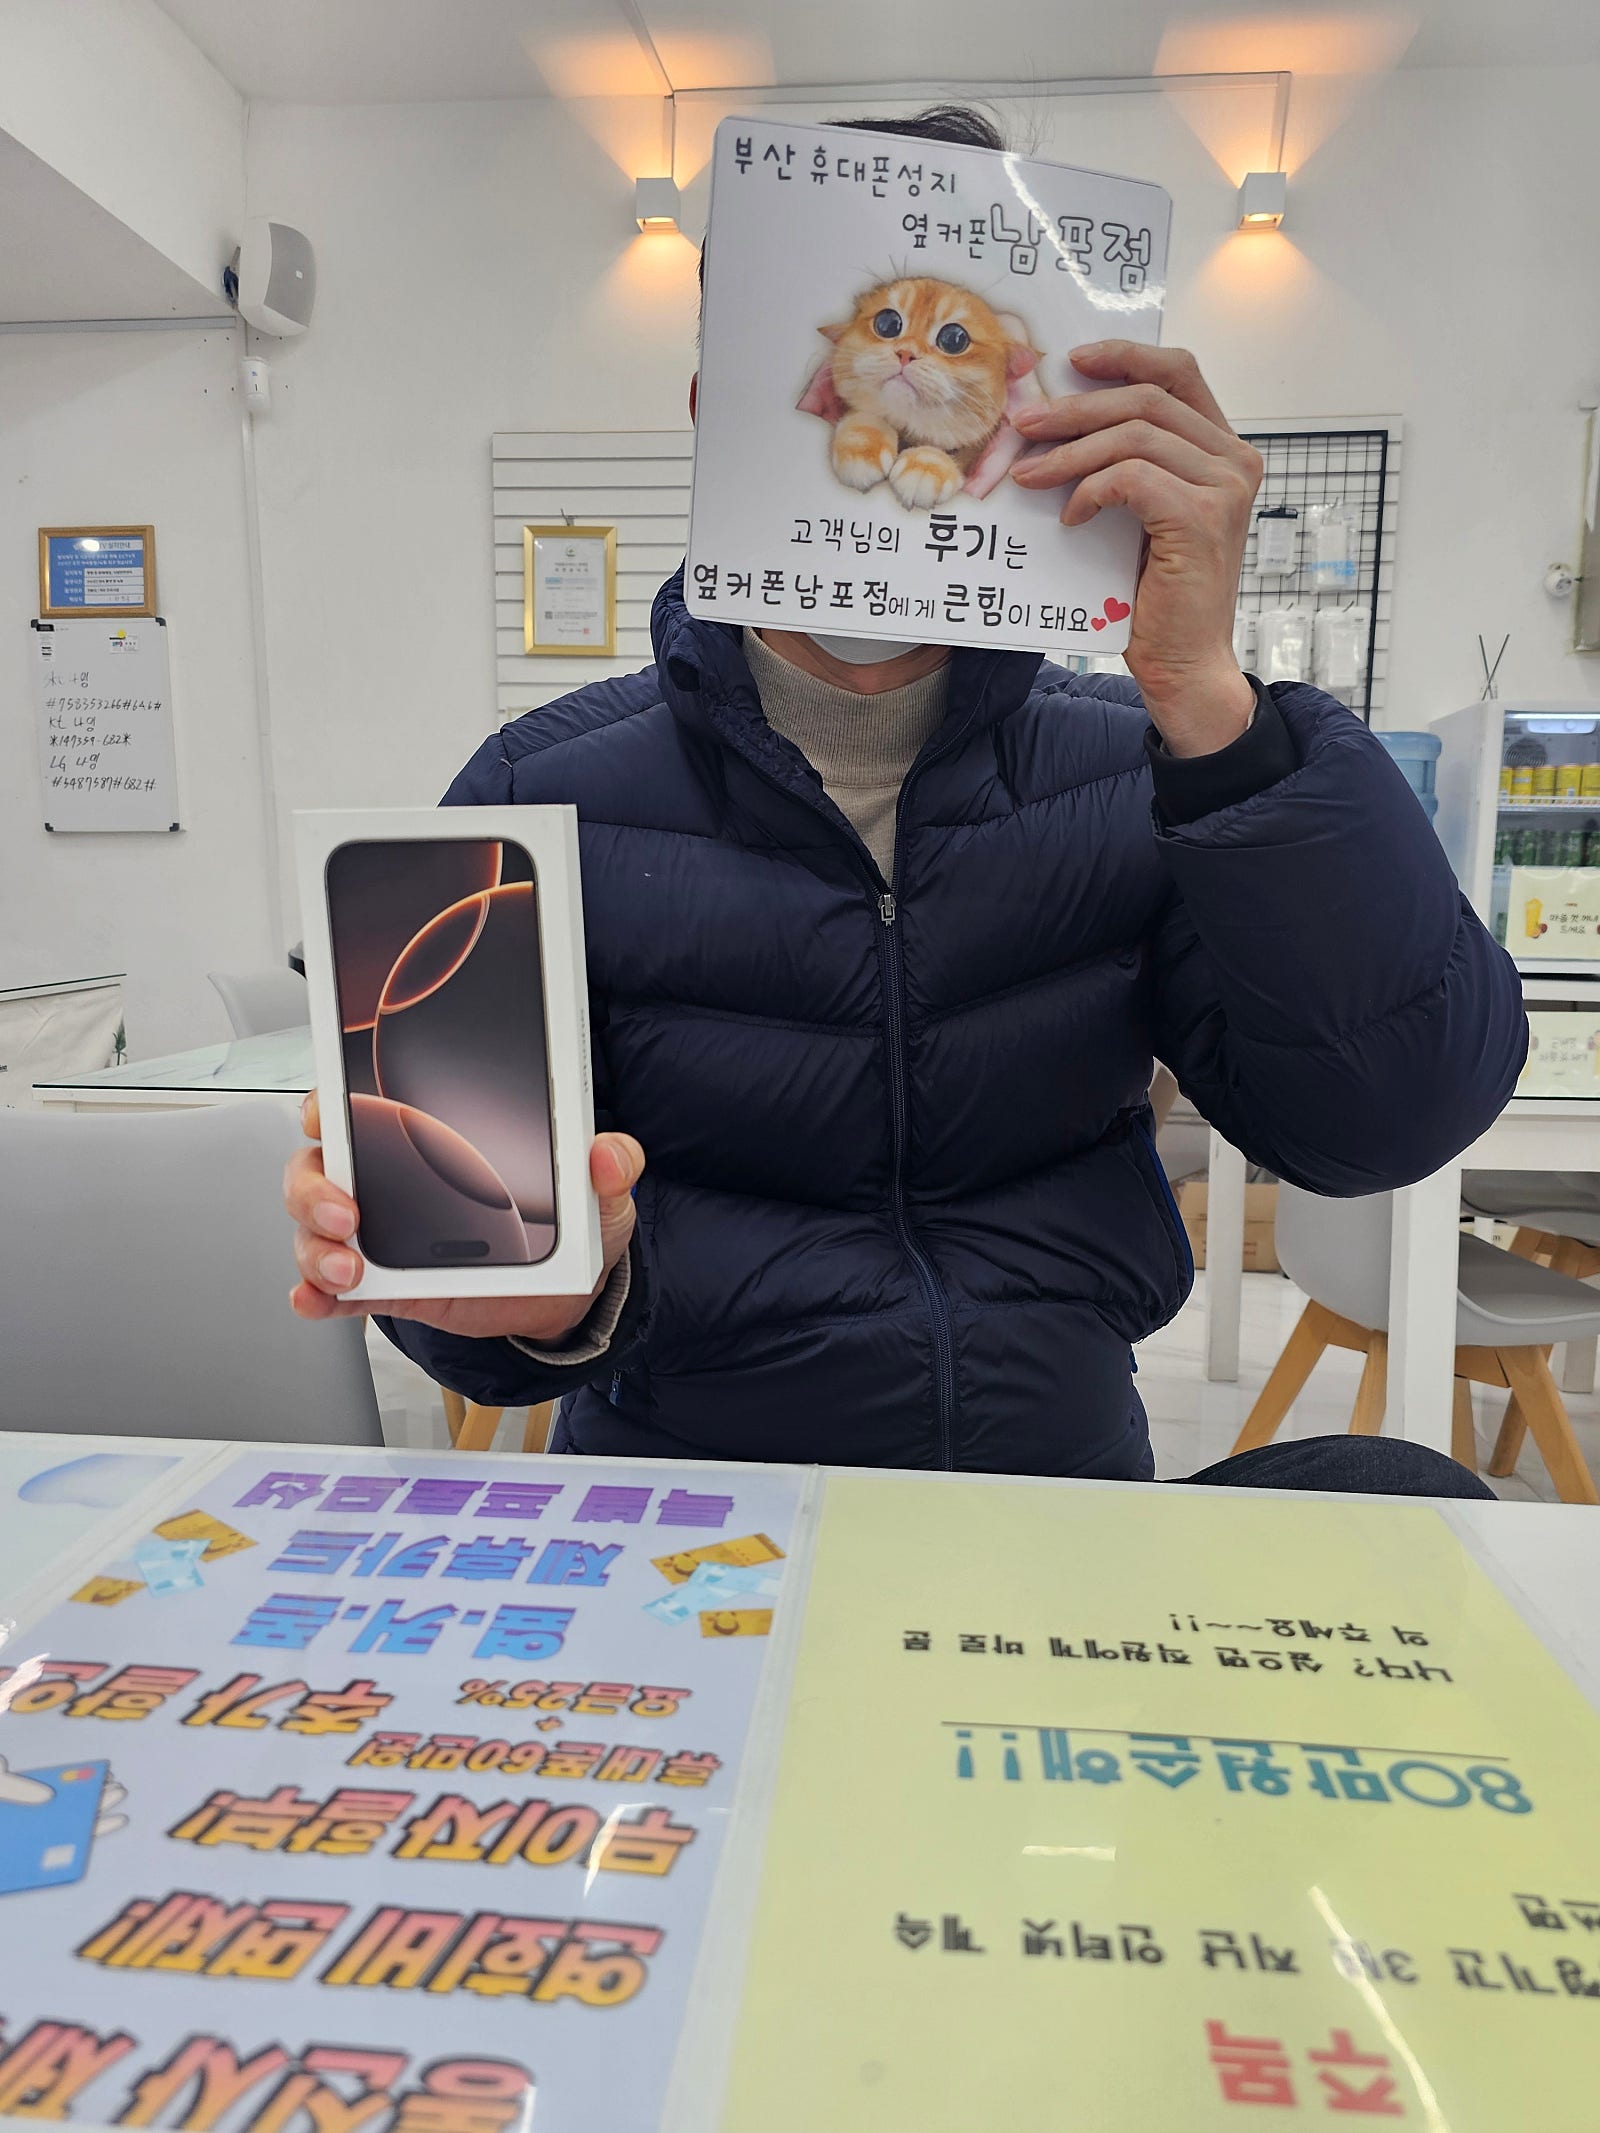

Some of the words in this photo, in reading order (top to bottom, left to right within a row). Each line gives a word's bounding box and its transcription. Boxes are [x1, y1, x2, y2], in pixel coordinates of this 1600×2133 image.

[734, 136, 796, 181] 부산
[810, 145, 957, 198] 휴대폰성지
[790, 518, 901, 554] 고객님의
[924, 513, 1028, 570] 후기는
[1038, 604, 1089, 633] 돼요
[49, 755, 66, 772] LG
[232, 1470, 566, 1520] 프로모션
[571, 1484, 734, 1529] 특별
[264, 1529, 627, 1587] 제휴카드
[903, 1630, 931, 1652] 문
[958, 1634, 1024, 1656] 바로
[1048, 1636, 1193, 1665] 직원에게
[1391, 1625, 1429, 1646] 의
[179, 1673, 395, 1736] 추가
[163, 1786, 415, 1857] 할부!
[389, 1792, 696, 1877] 무이자
[72, 1892, 350, 1985] 면제!
[319, 1904, 664, 2010] 연회비
[1022, 1920, 1165, 1965] 인터넷
[1197, 1929, 1300, 1976] 지난
[1203, 2019, 1405, 2118] 주목
